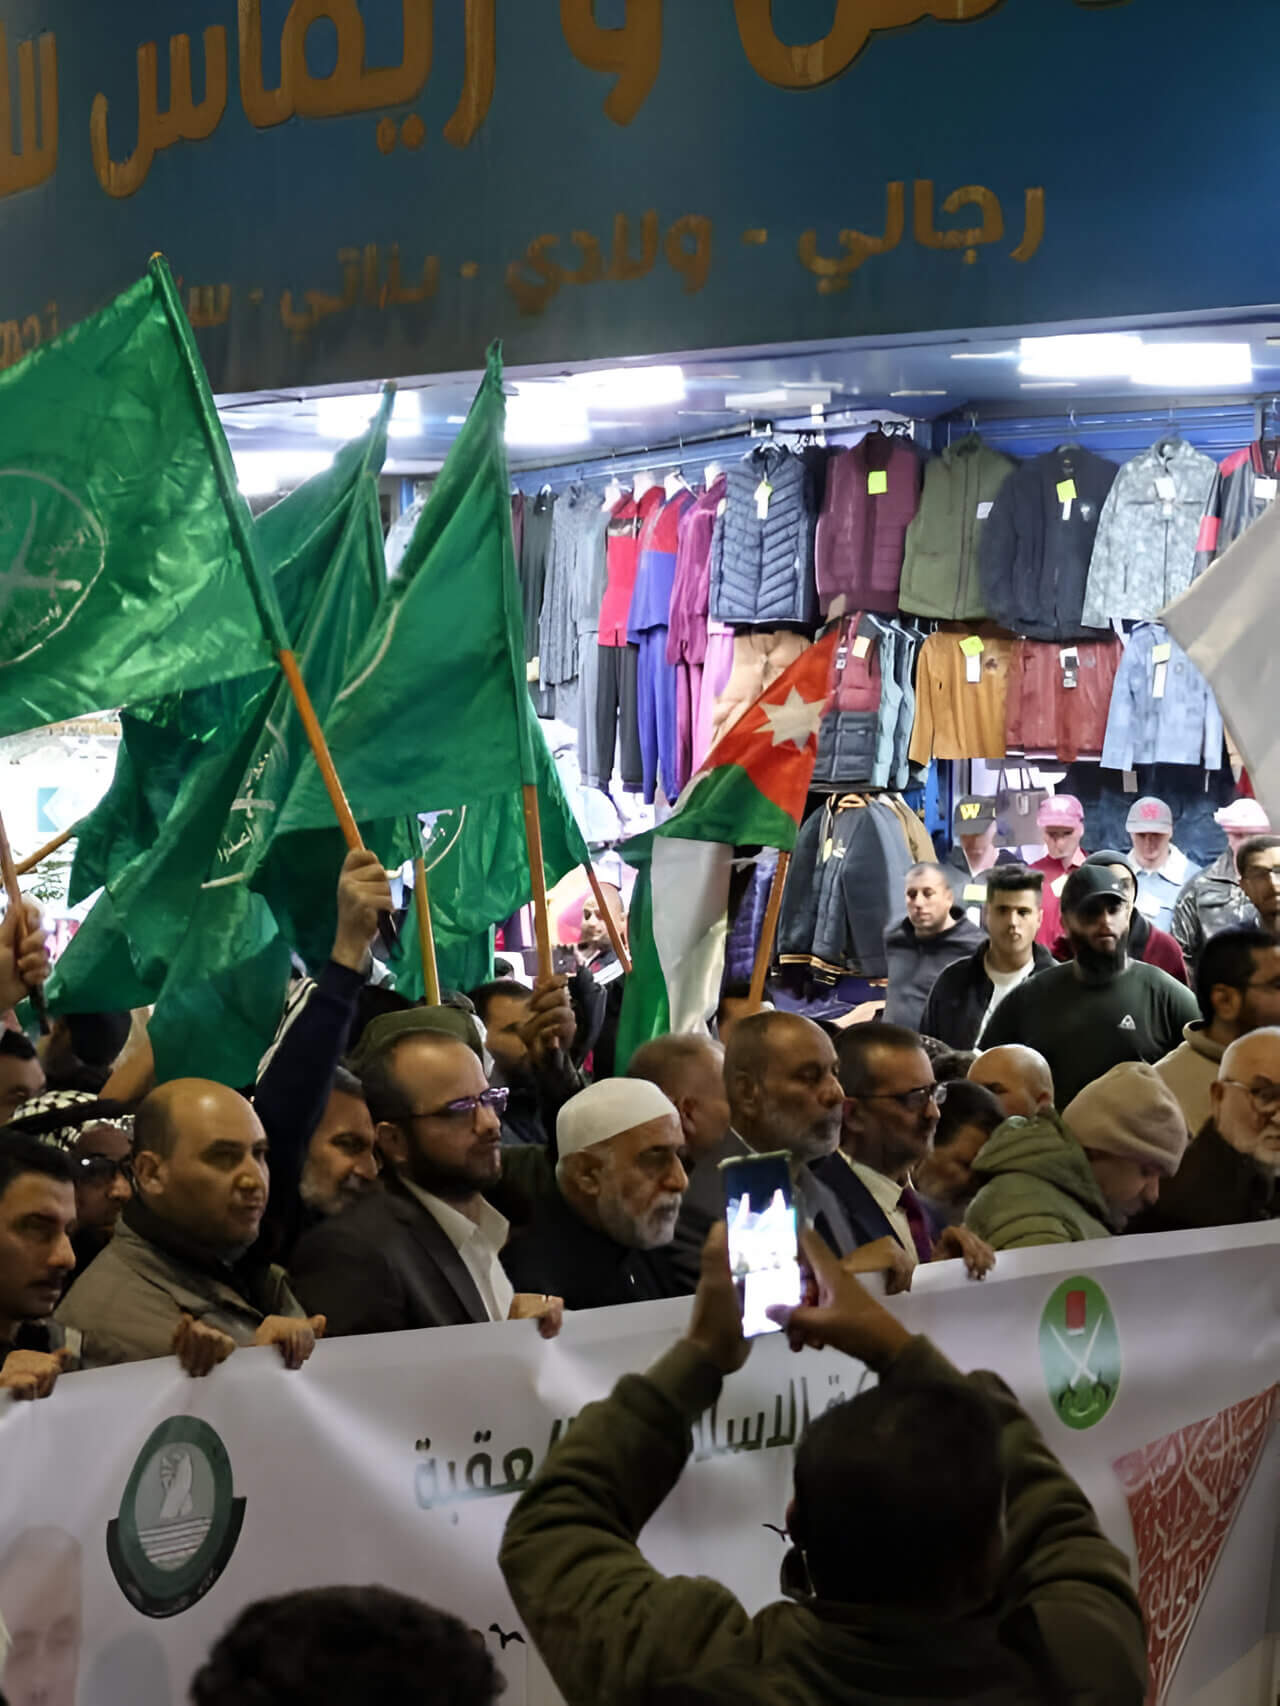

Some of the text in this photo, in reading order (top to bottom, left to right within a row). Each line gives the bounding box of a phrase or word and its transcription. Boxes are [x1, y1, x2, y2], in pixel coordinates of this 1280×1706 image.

[507, 208, 714, 317] ولادي
[798, 179, 1046, 294] رجالي
[960, 803, 980, 820] W
